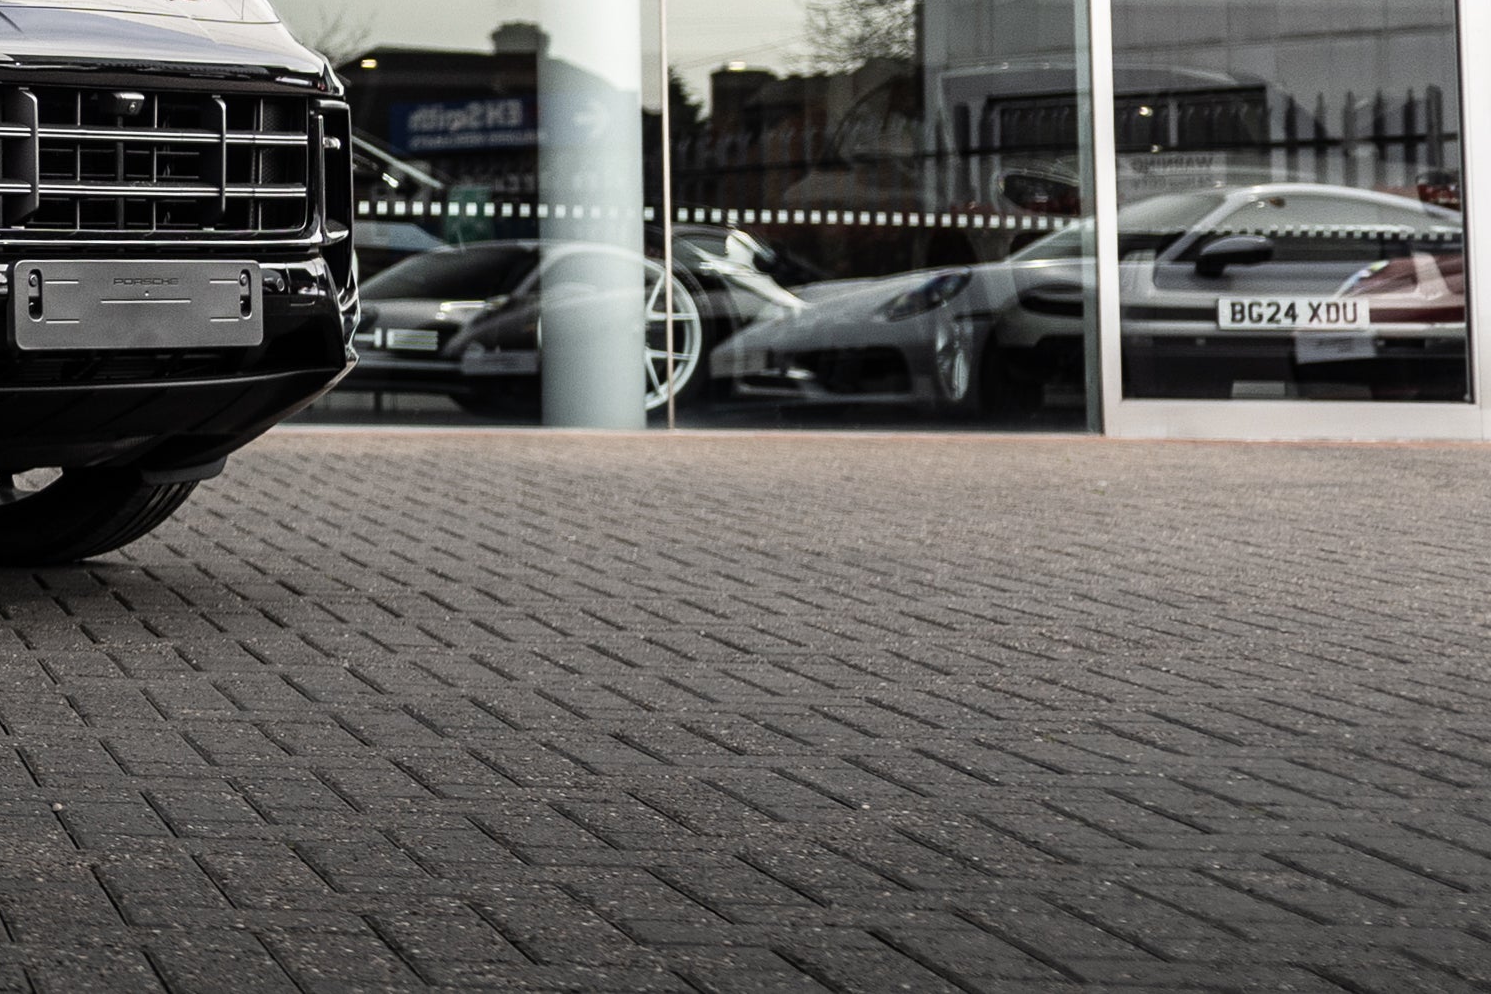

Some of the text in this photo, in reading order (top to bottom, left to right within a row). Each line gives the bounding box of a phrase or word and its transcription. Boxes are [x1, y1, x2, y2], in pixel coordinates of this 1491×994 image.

[113, 277, 179, 285] PORSCHE
[1230, 300, 1358, 324] BG24 XDU
